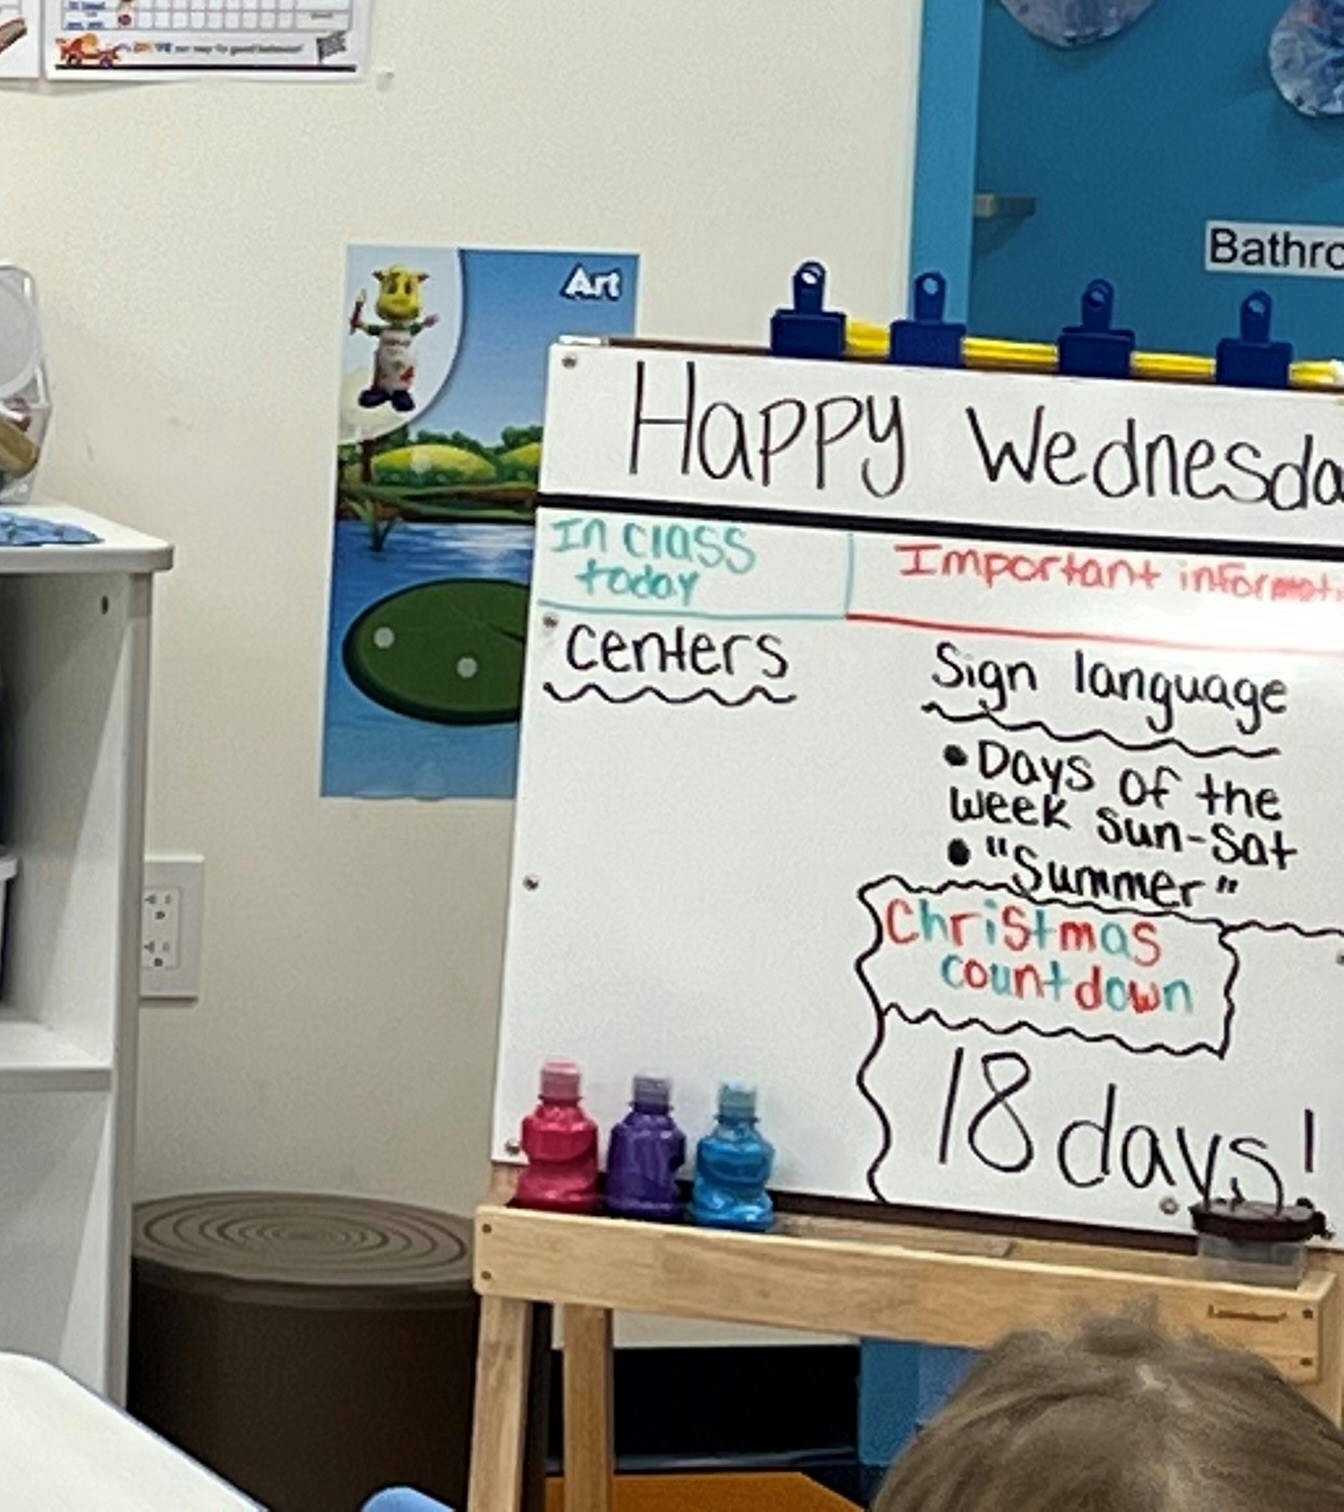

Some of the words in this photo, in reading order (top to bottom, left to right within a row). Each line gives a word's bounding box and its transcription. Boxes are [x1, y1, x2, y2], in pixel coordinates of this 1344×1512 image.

[1210, 227, 1344, 271] Bathro
[562, 265, 621, 302] Art
[628, 360, 906, 499] Happy
[965, 404, 1344, 512] Wednesda
[551, 517, 609, 554] In
[575, 558, 701, 607] today
[894, 542, 1161, 592] Important
[931, 641, 1038, 712] Sign
[1074, 649, 1288, 735] language
[977, 739, 1096, 795] Days
[1194, 772, 1283, 821] the
[885, 896, 1162, 968] Christmas
[940, 953, 1194, 1014] countdown
[937, 1046, 1034, 1175] 18
